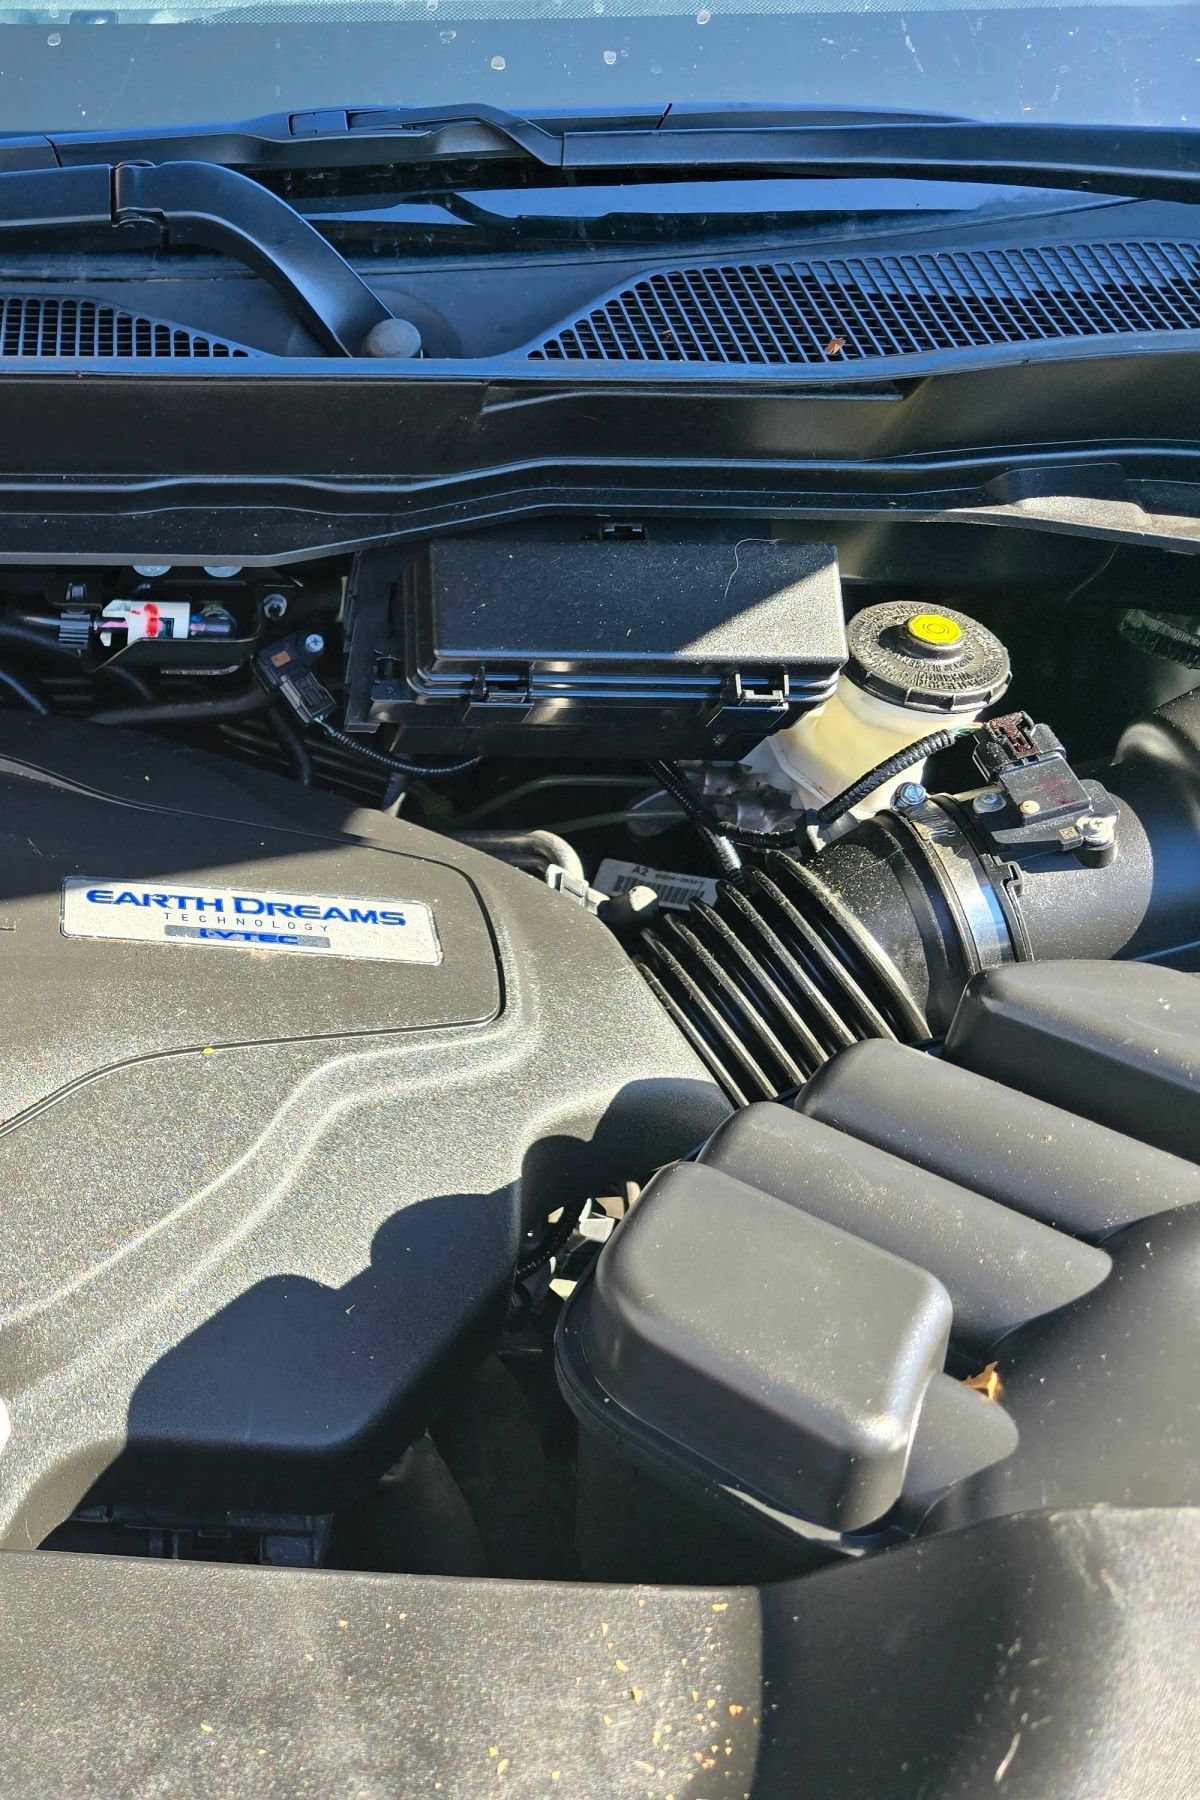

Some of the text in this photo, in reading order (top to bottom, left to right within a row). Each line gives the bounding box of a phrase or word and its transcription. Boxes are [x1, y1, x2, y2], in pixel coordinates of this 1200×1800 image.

[631, 865, 649, 877] A2
[86, 888, 407, 926] EARTH DREAMS
[164, 911, 330, 932] TECHNOLOGY
